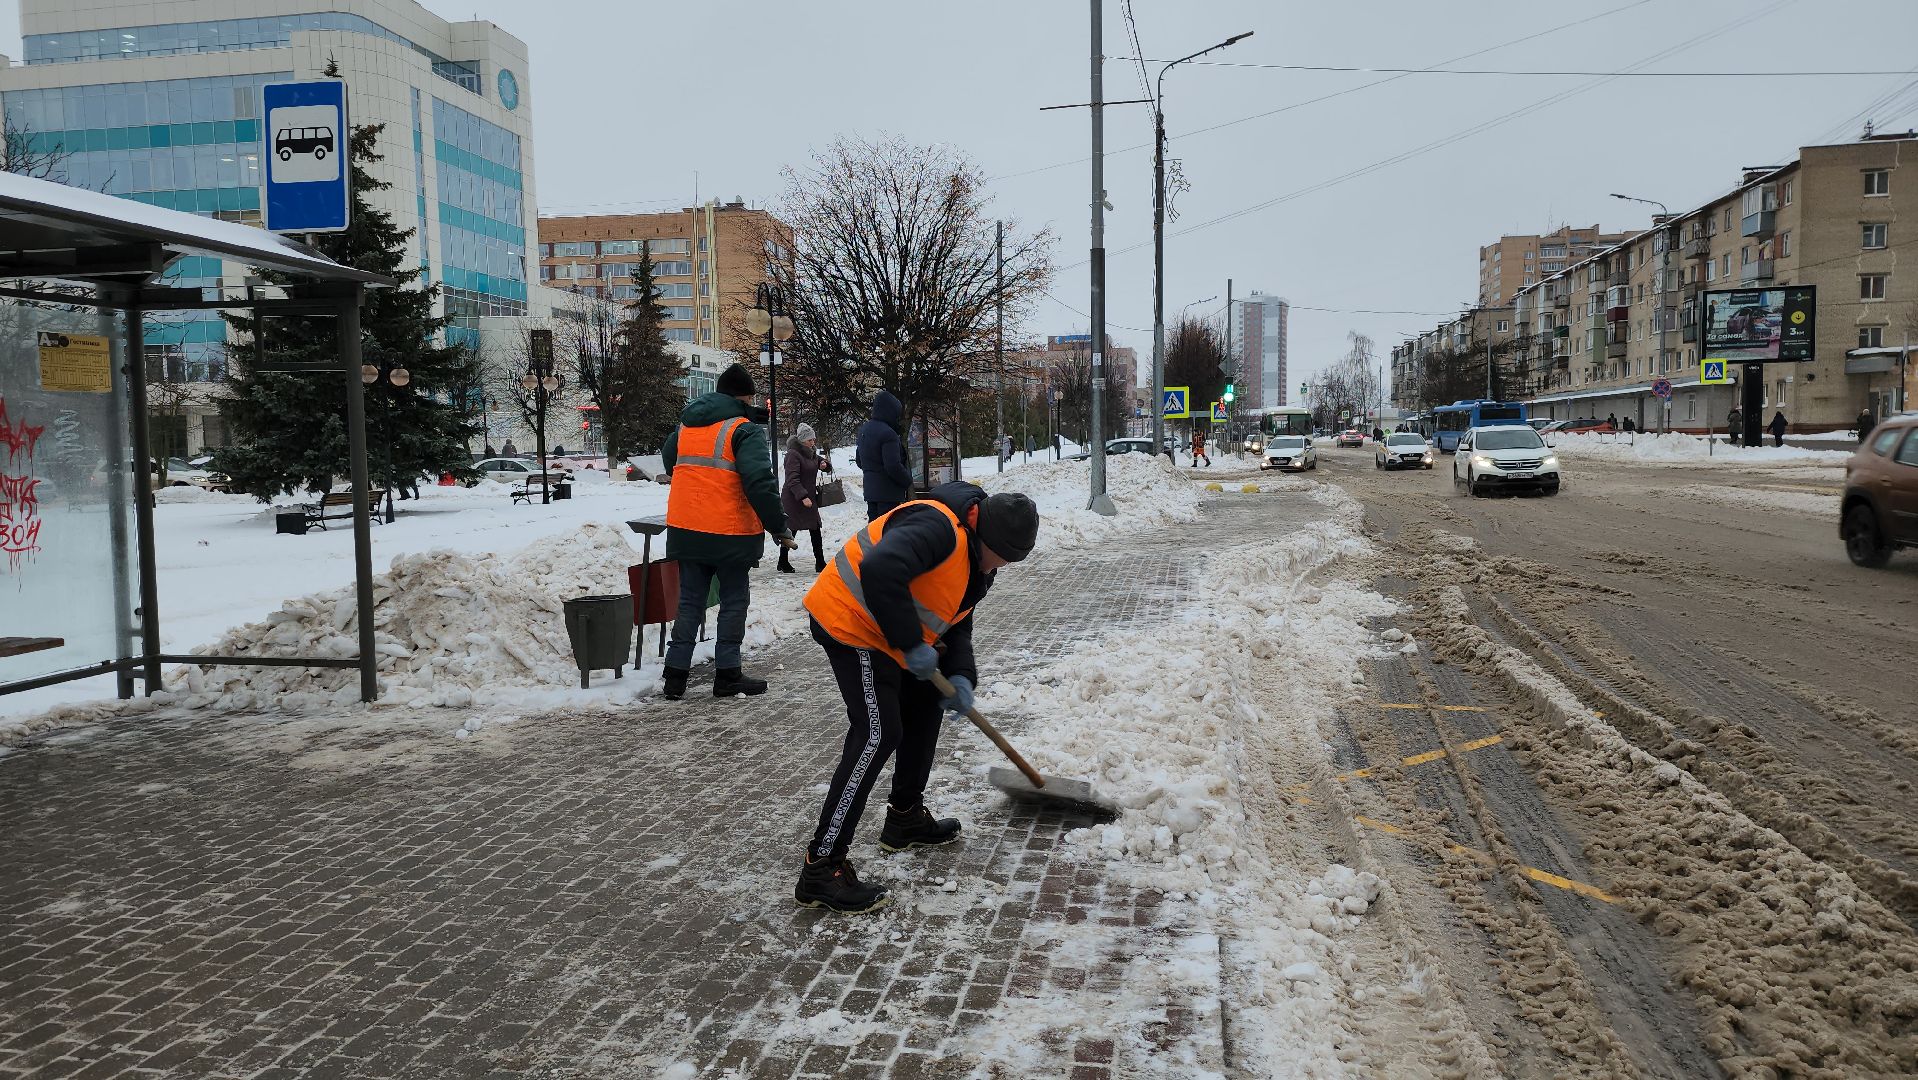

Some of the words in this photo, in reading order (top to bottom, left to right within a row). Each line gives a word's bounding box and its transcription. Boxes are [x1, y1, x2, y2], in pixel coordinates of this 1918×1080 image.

[834, 785, 855, 821] LONDON
[853, 741, 876, 780] LONSDALE
[869, 706, 880, 742] LONDON
